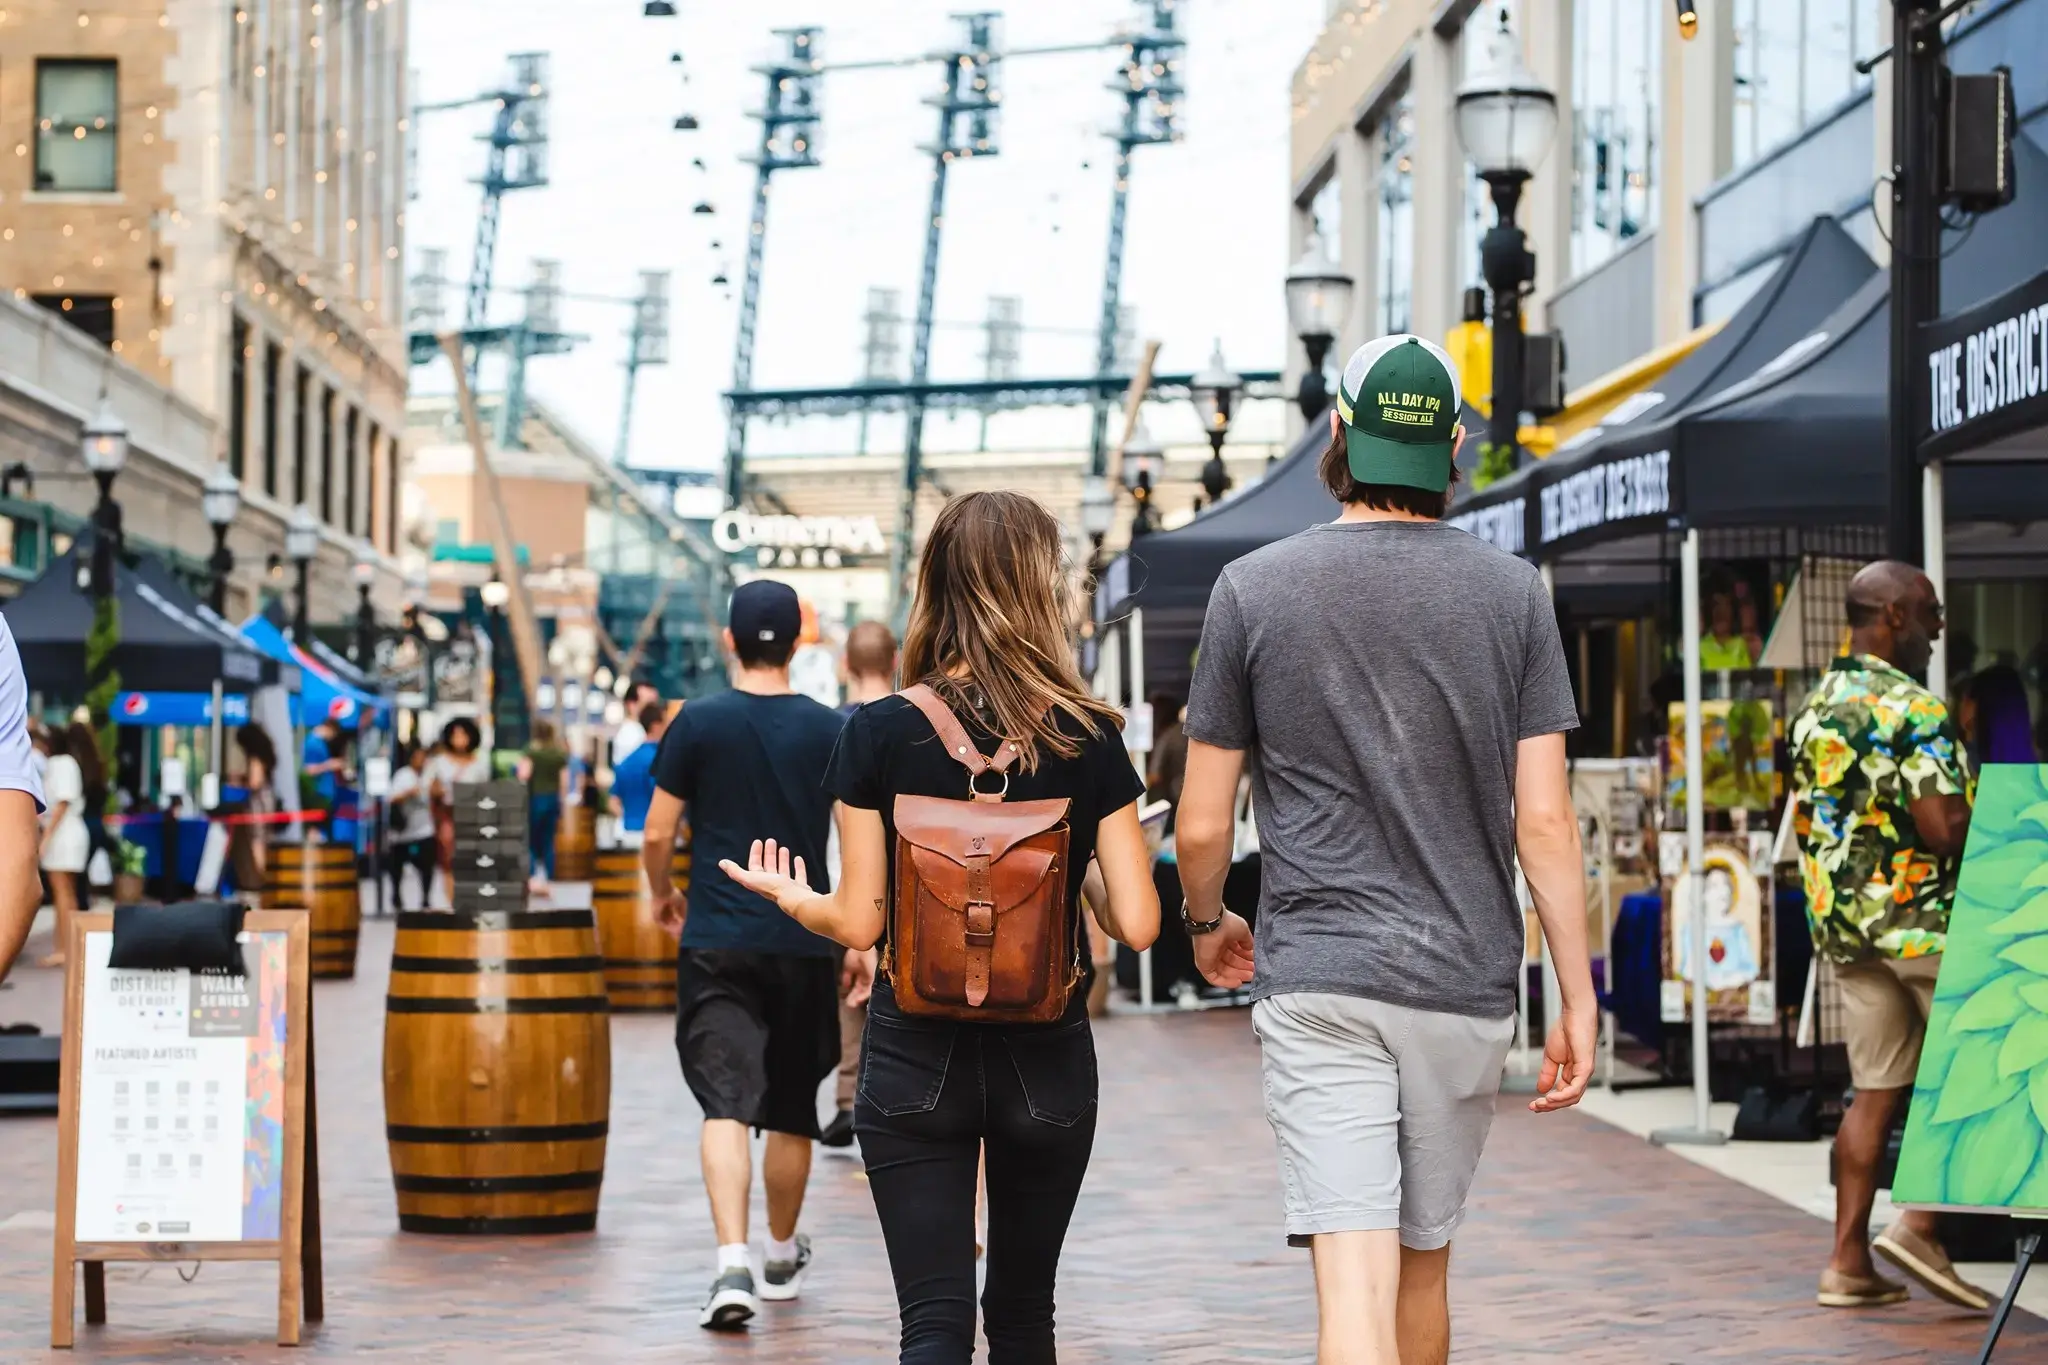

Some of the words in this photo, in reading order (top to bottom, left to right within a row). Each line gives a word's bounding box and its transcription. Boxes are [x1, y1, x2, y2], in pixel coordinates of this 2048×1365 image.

[1929, 342, 1962, 432] THE
[1966, 303, 2048, 419] DISTRICT
[1378, 392, 1399, 405] ALL
[1402, 393, 1424, 408] DAY
[1426, 396, 1440, 413] IPA
[1382, 409, 1418, 422] SESSION
[1420, 414, 1434, 423] ALE
[110, 976, 177, 992] DISTRICT
[201, 975, 245, 993] WALK
[118, 995, 176, 1007] DETROIT
[200, 994, 250, 1008] SERIES
[94, 1048, 150, 1061] FEATURED
[152, 1048, 197, 1061] ARTISTS
